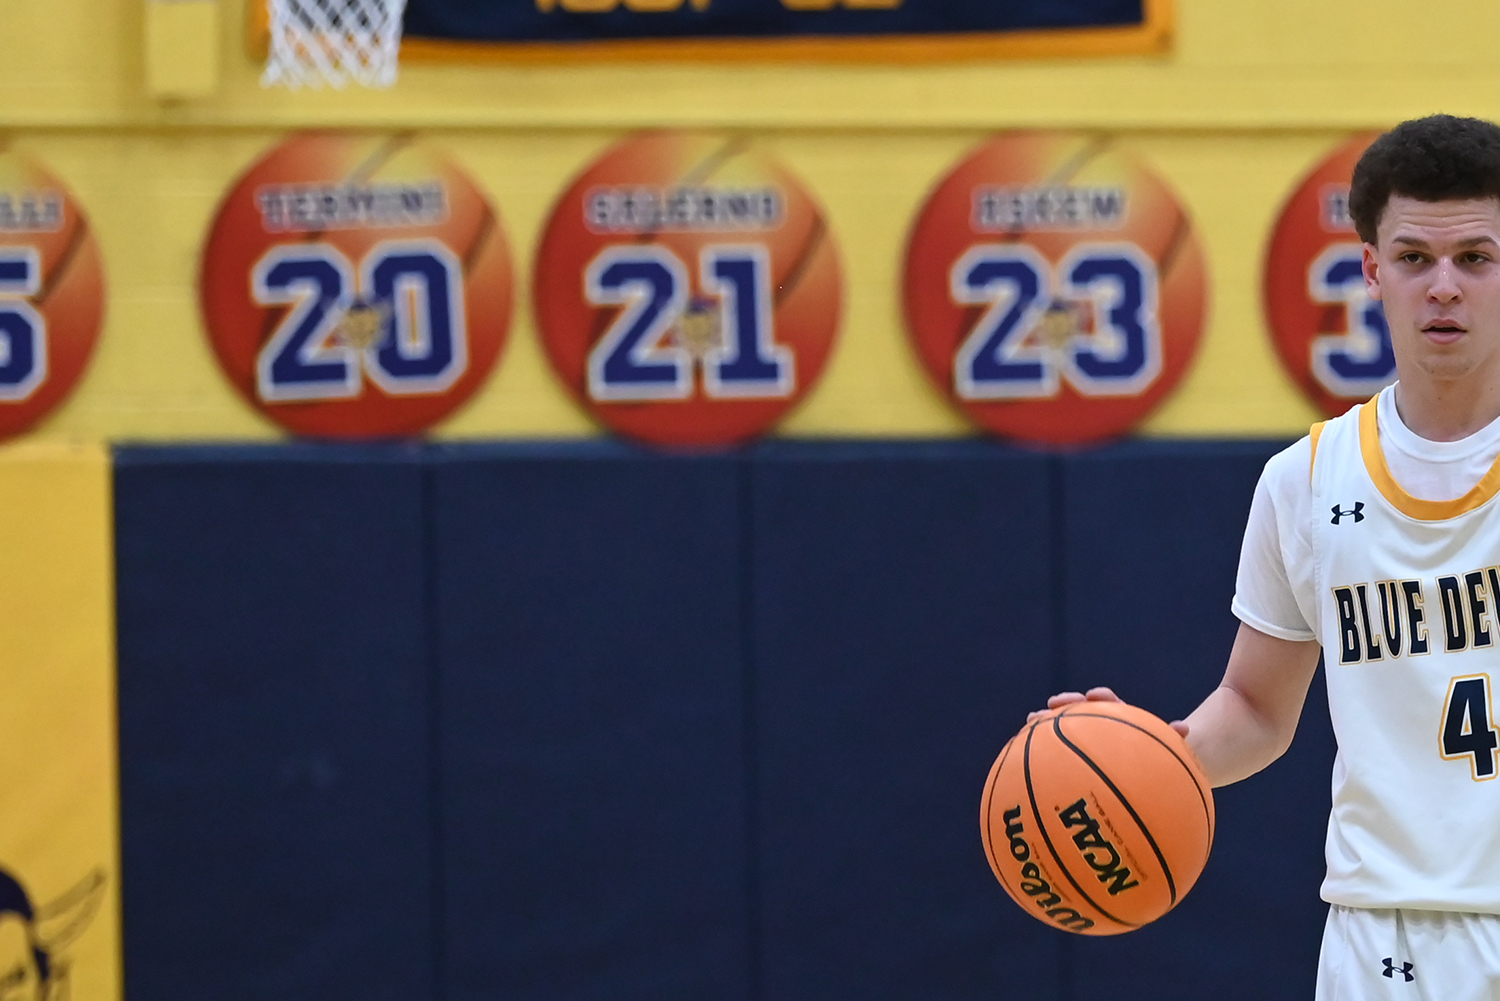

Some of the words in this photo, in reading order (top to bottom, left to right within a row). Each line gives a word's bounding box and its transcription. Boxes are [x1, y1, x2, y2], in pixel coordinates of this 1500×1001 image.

[252, 239, 468, 404] 20
[584, 241, 795, 403] 21
[949, 240, 1164, 402] 23
[1331, 579, 1431, 665] BLUE
[1003, 804, 1095, 932] Wilson
[1058, 798, 1140, 896] NCAA
